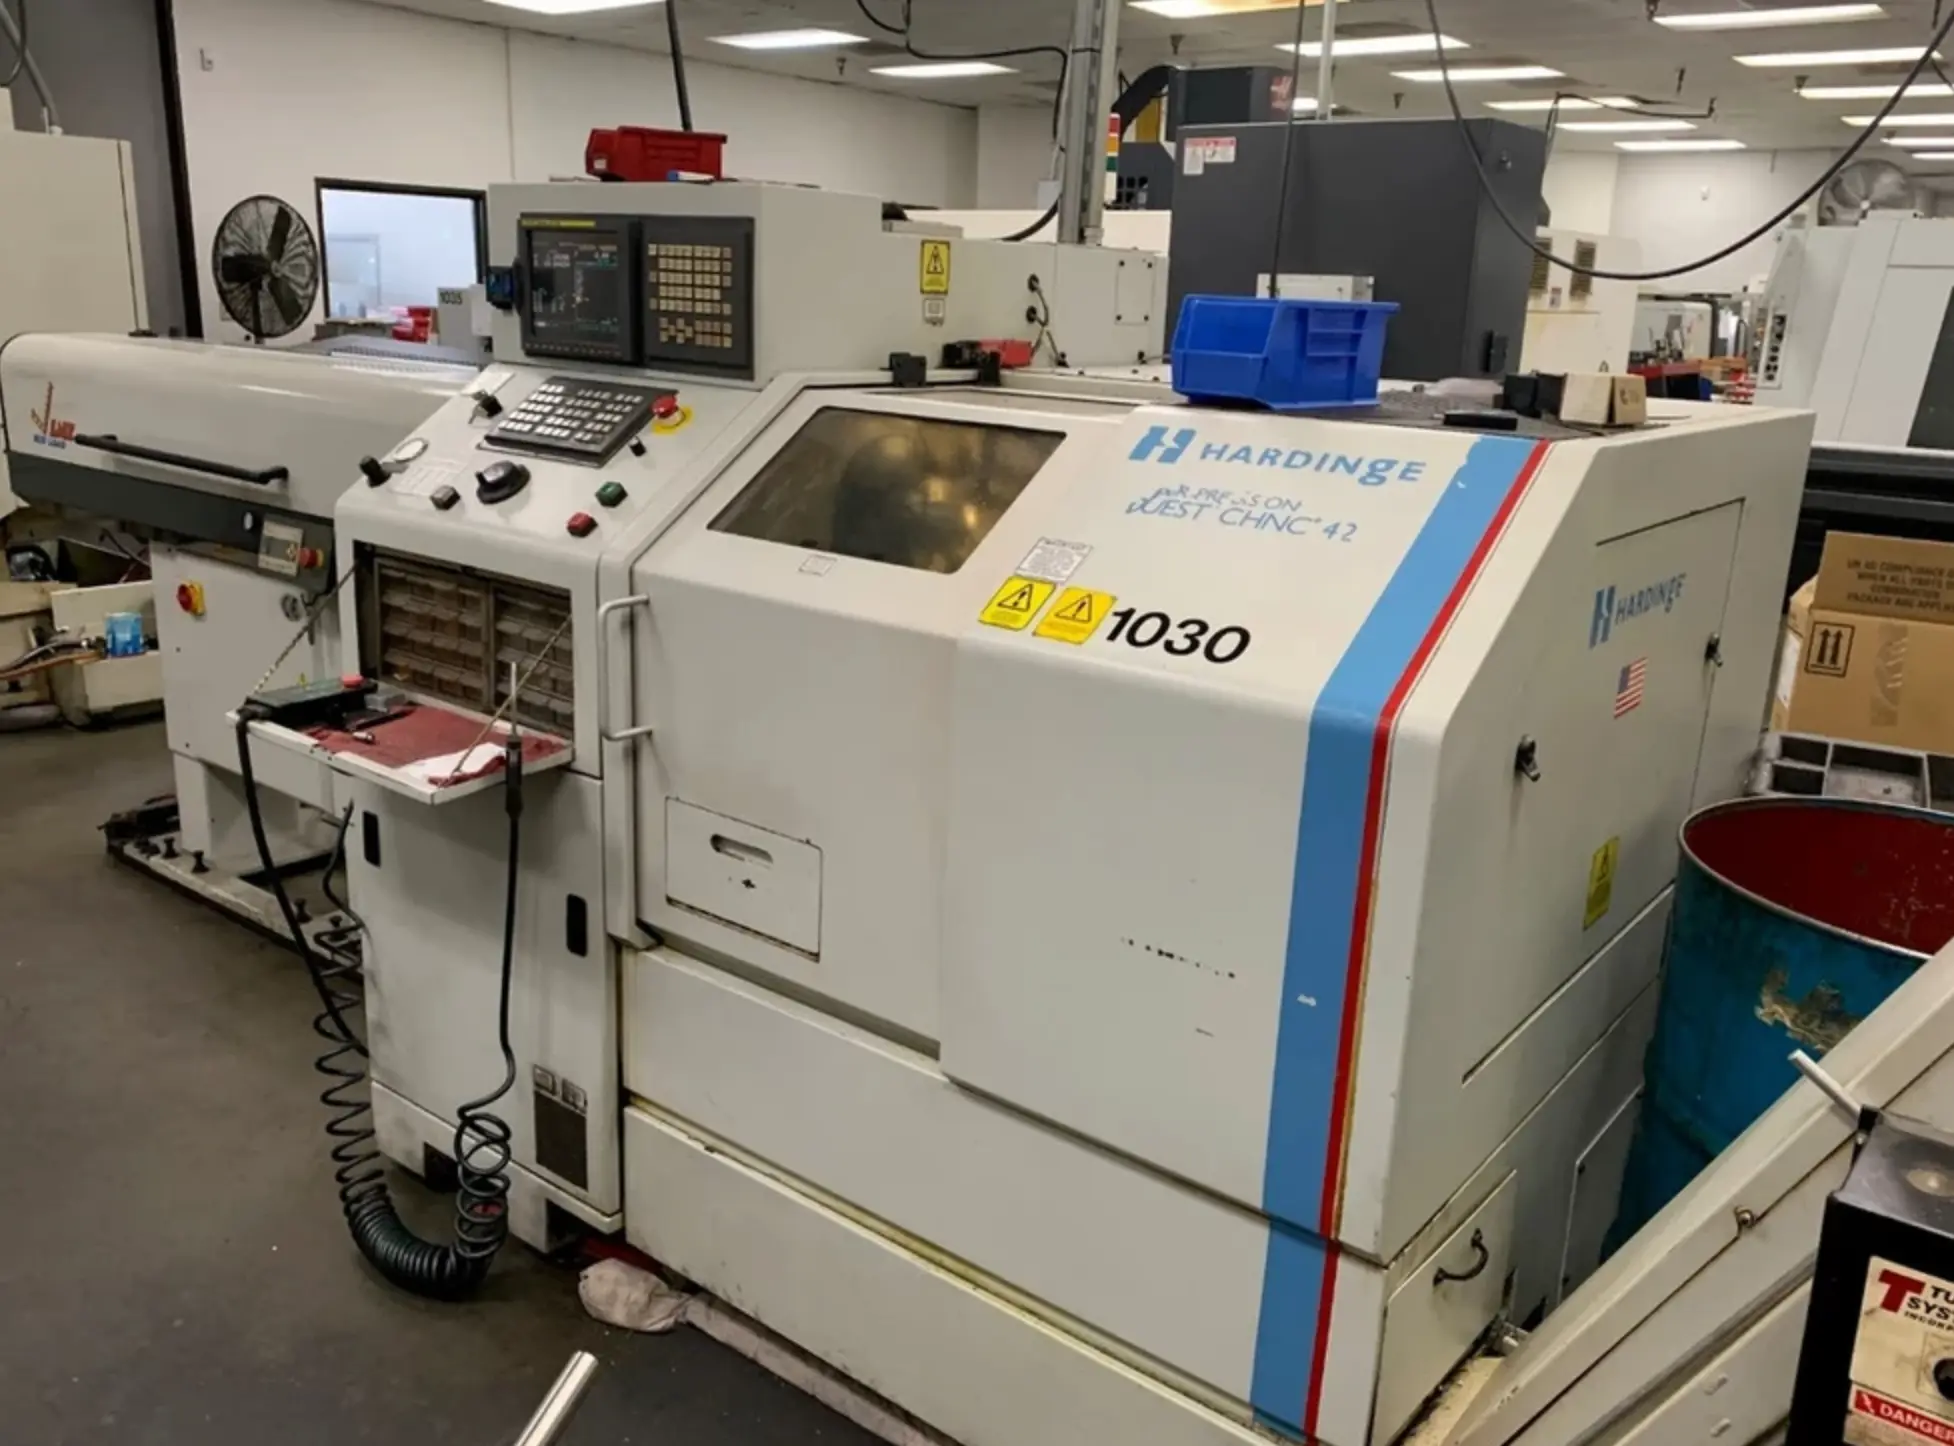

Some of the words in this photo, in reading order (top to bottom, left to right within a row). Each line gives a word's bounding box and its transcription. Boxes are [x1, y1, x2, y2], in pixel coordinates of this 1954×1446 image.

[1322, 521, 1358, 543] 42
[1106, 606, 1251, 665] 1030
[1907, 1296, 1954, 1321] SYS
